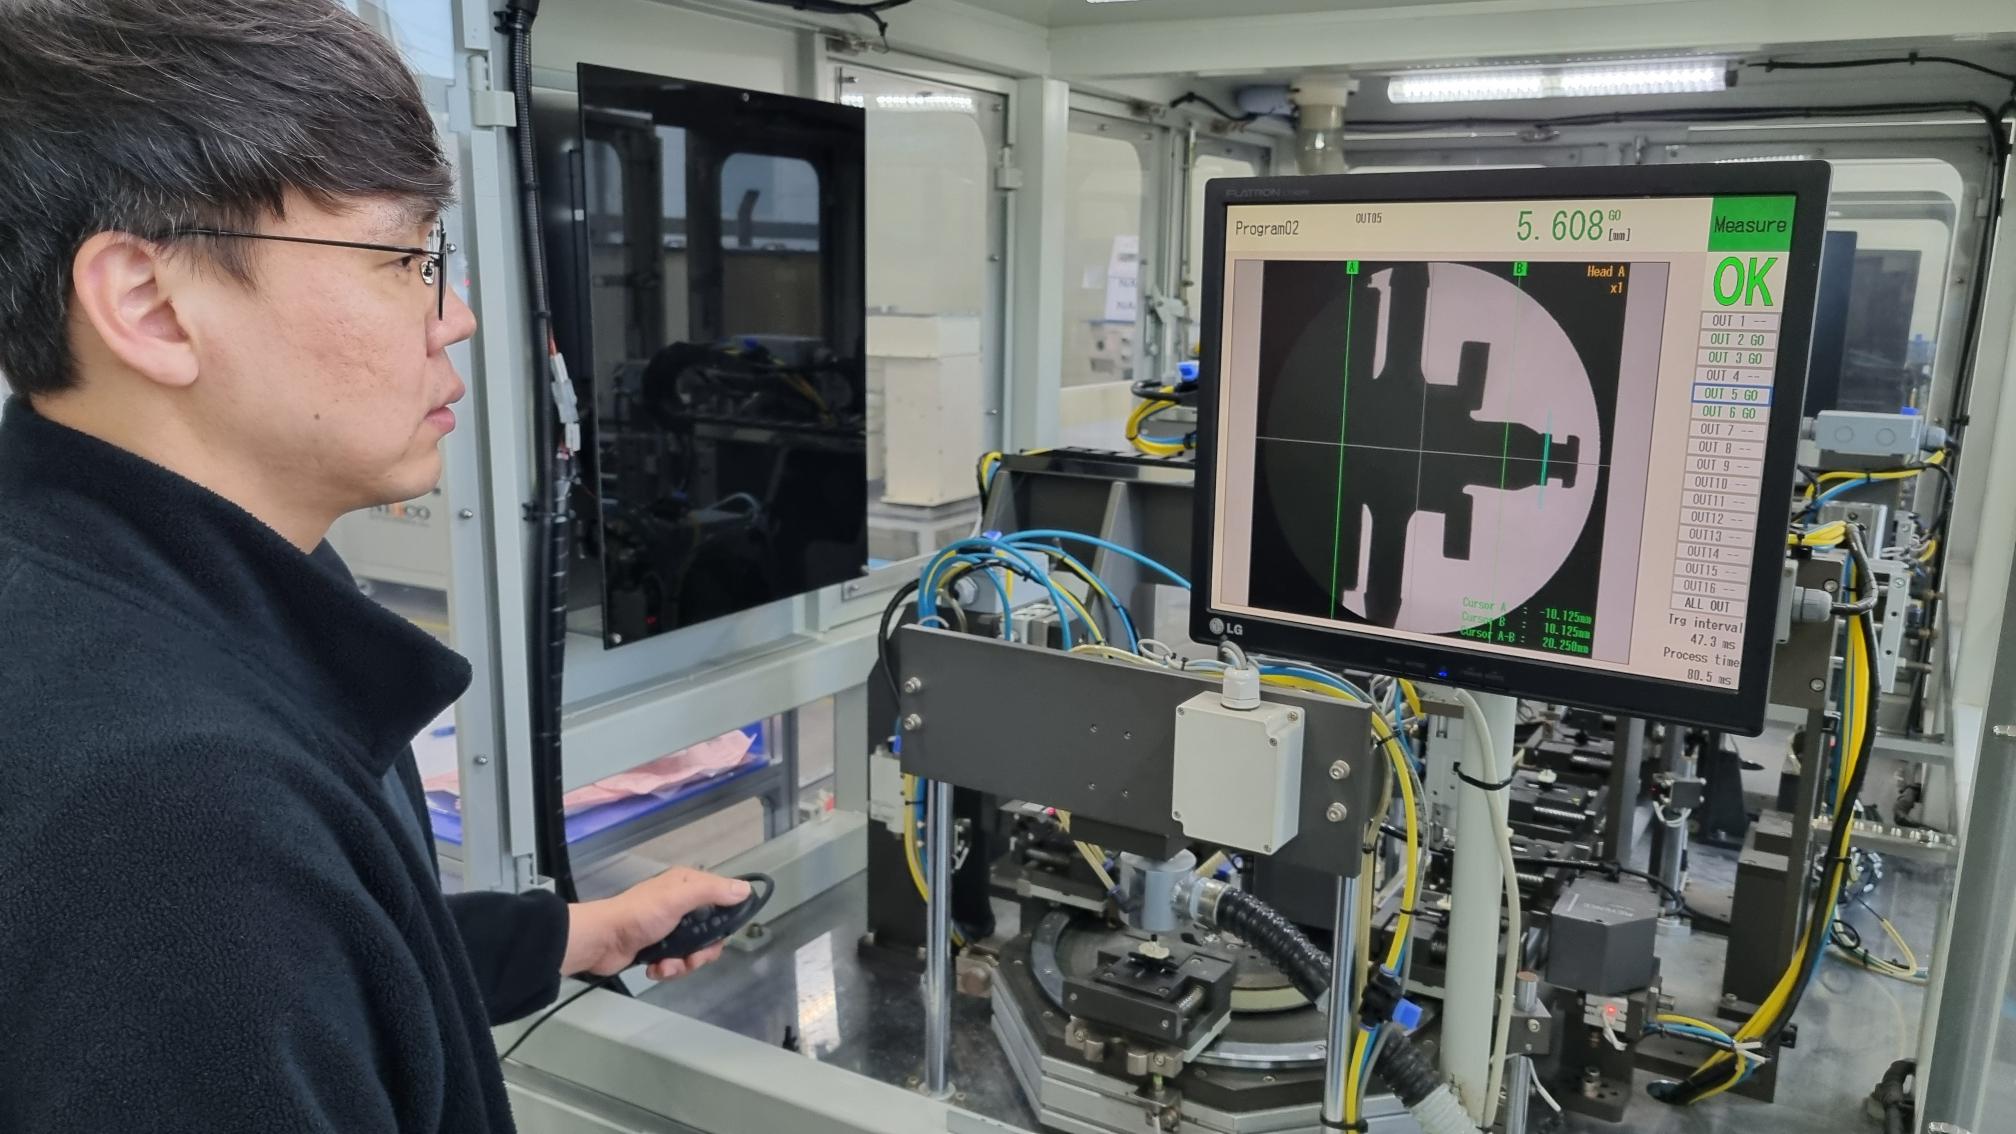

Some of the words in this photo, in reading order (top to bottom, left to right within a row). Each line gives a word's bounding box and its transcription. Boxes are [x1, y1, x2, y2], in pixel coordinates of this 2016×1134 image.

[1356, 212, 1382, 223] OUT05
[1608, 209, 1621, 220] GO
[1235, 220, 1299, 236] Program02
[1714, 215, 1787, 233] Measure
[1587, 264, 1613, 277] Head
[1618, 265, 1625, 277] A
[1713, 256, 1778, 306] OK
[1712, 314, 1733, 326] OUT
[1710, 333, 1730, 345] OUT
[1750, 334, 1765, 346] GO
[1708, 351, 1728, 363] OUT
[1748, 352, 1763, 365] GO
[1706, 369, 1727, 381] OUT
[1704, 387, 1724, 399] OUT
[1744, 389, 1758, 401] GO
[1702, 405, 1722, 417] OUT
[1742, 407, 1756, 419] GO
[1700, 423, 1720, 435] OUT
[1698, 441, 1719, 453] OUT
[1696, 458, 1716, 471] OUT
[1694, 475, 1728, 489] OUT10
[1692, 493, 1724, 507] OUT11
[1691, 511, 1724, 524] OUT12
[1688, 528, 1722, 542] OUT13
[1687, 545, 1720, 559] OUT14
[1685, 562, 1718, 577] OUT15
[1683, 579, 1716, 594] OUT16
[1462, 596, 1495, 610] Cursor
[1500, 602, 1507, 611] A
[1684, 597, 1703, 610] ALL
[1710, 600, 1731, 613] OUT
[1462, 611, 1493, 625] Cursor
[1499, 616, 1506, 627] B
[1669, 613, 1687, 627] Trg
[1694, 616, 1743, 634] interval
[1226, 622, 1243, 636] LG
[1497, 630, 1516, 643] A-B
[1690, 633, 1717, 647] 47.3
[1721, 640, 1736, 650] ms
[1663, 646, 1708, 663] Process
[1715, 653, 1740, 668] time
[1687, 668, 1713, 682] 80.5
[1718, 676, 1732, 685] ms
